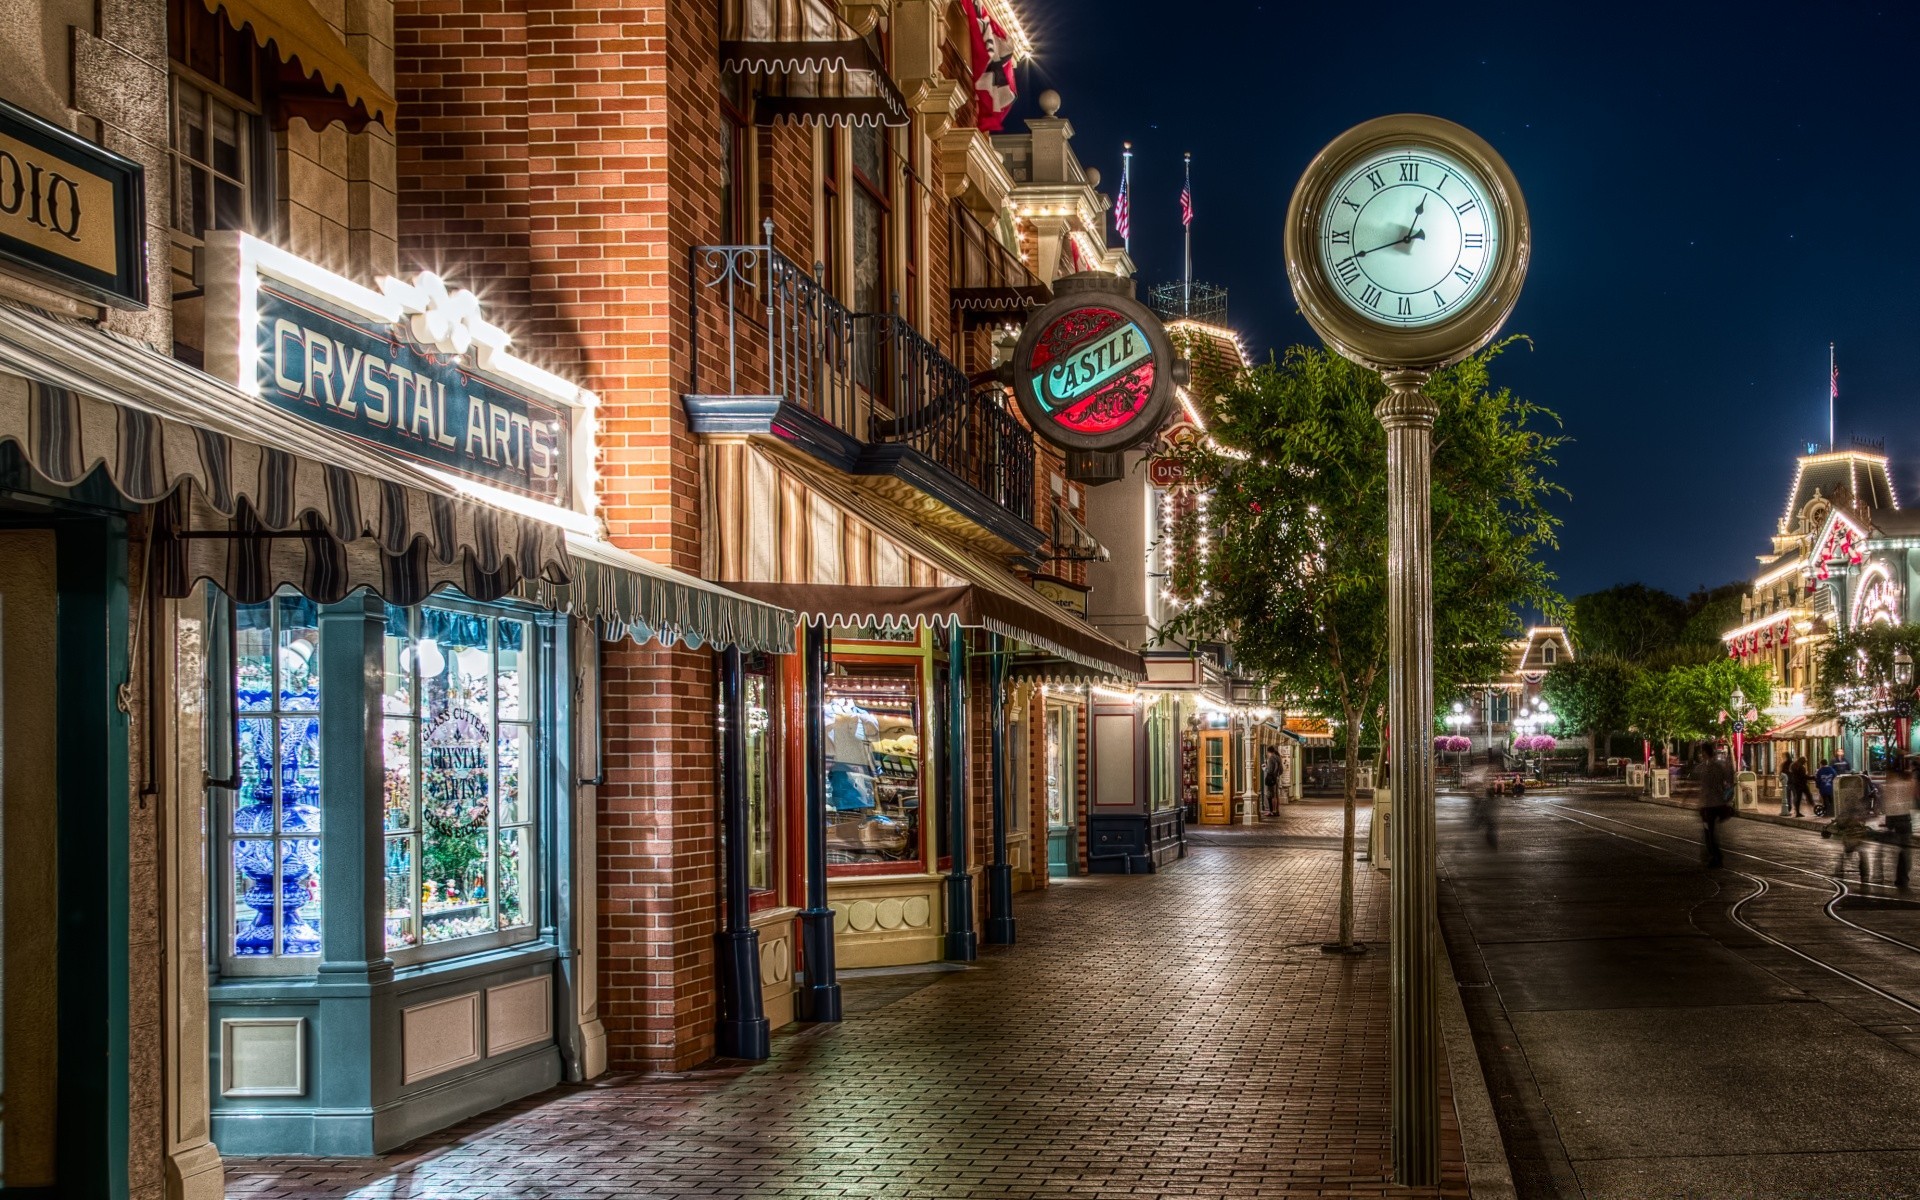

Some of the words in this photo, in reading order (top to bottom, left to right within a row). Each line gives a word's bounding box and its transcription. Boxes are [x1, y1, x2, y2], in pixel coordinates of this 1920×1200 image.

[1366, 170, 1385, 191] XI
[1399, 163, 1419, 182] XII
[1342, 196, 1360, 212] X
[1456, 199, 1476, 215] II
[1332, 230, 1350, 244] IX
[1465, 233, 1483, 249] III
[1454, 264, 1474, 284] IV
[1360, 284, 1382, 309] VII
[1398, 297, 1412, 315] VI
[1433, 290, 1446, 307] V
[1042, 328, 1134, 405] CASTLE
[274, 317, 457, 448] CRYSTAL
[465, 394, 551, 479] ARTS
[423, 709, 450, 742] GLASS
[453, 707, 490, 743] CUTTERS
[430, 747, 489, 769] CRYSTAL
[440, 777, 476, 800] ARTS
[424, 808, 453, 838] GLASS
[455, 805, 490, 838] ETCHING
